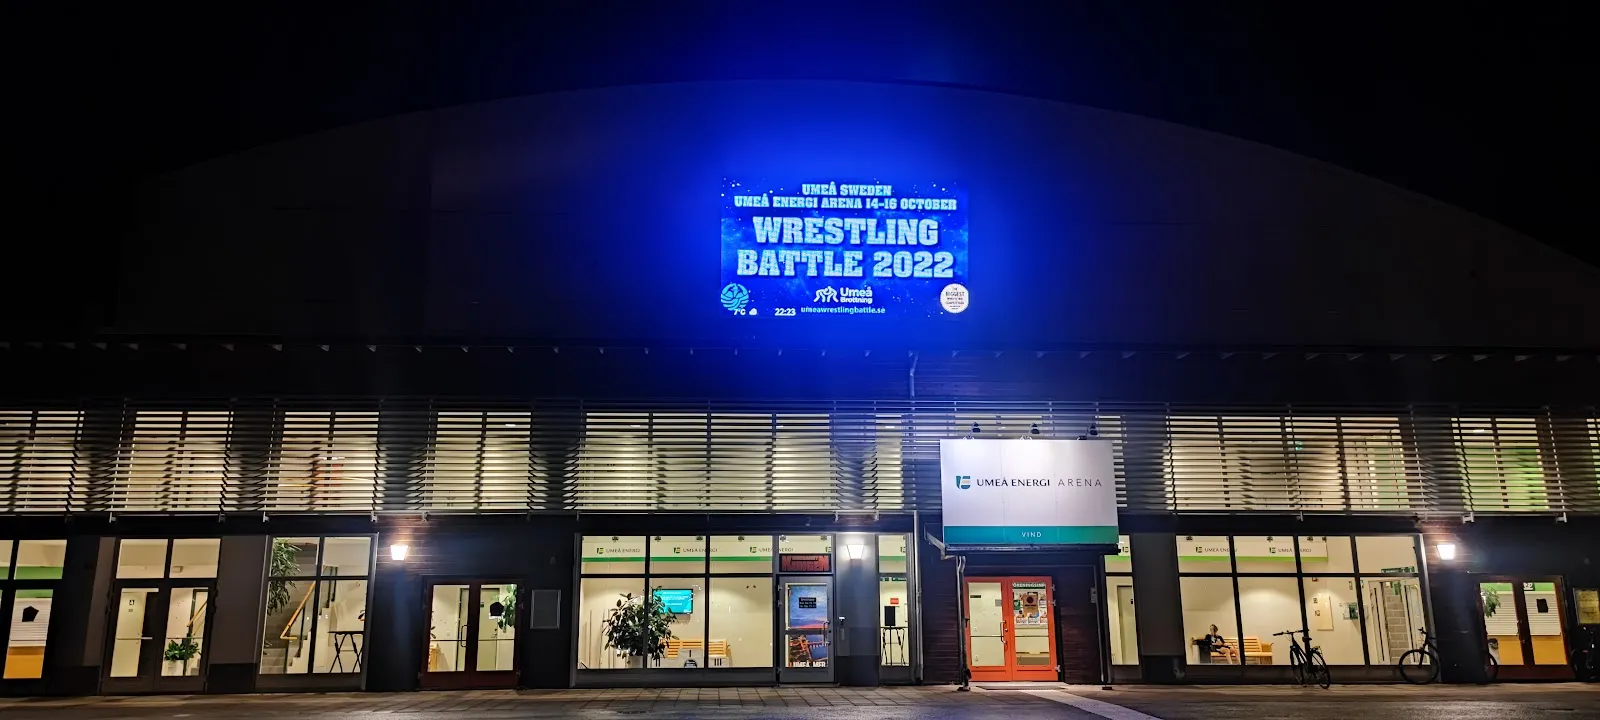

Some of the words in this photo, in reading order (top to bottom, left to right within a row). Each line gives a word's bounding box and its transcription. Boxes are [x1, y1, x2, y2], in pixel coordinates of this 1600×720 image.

[802, 181, 836, 196] UMEÅ
[840, 184, 892, 196] SWEDEN
[734, 193, 769, 207] UMEÅ
[773, 196, 818, 208] ENERGI
[821, 197, 863, 209] ARENA
[865, 198, 898, 210] 14-16
[900, 198, 957, 210] OCTOBER
[752, 216, 939, 246] WRESTLING
[737, 249, 863, 277] BATTLE
[873, 251, 954, 278] 2022
[840, 286, 873, 297] Umeå
[840, 296, 873, 304] Brottning
[774, 308, 796, 316] 22:23
[800, 305, 886, 315] umeawrestlingbattle.se
[976, 477, 1008, 487] UMEÅ
[1011, 478, 1050, 487] ENERGI
[1058, 479, 1102, 487] ARENA
